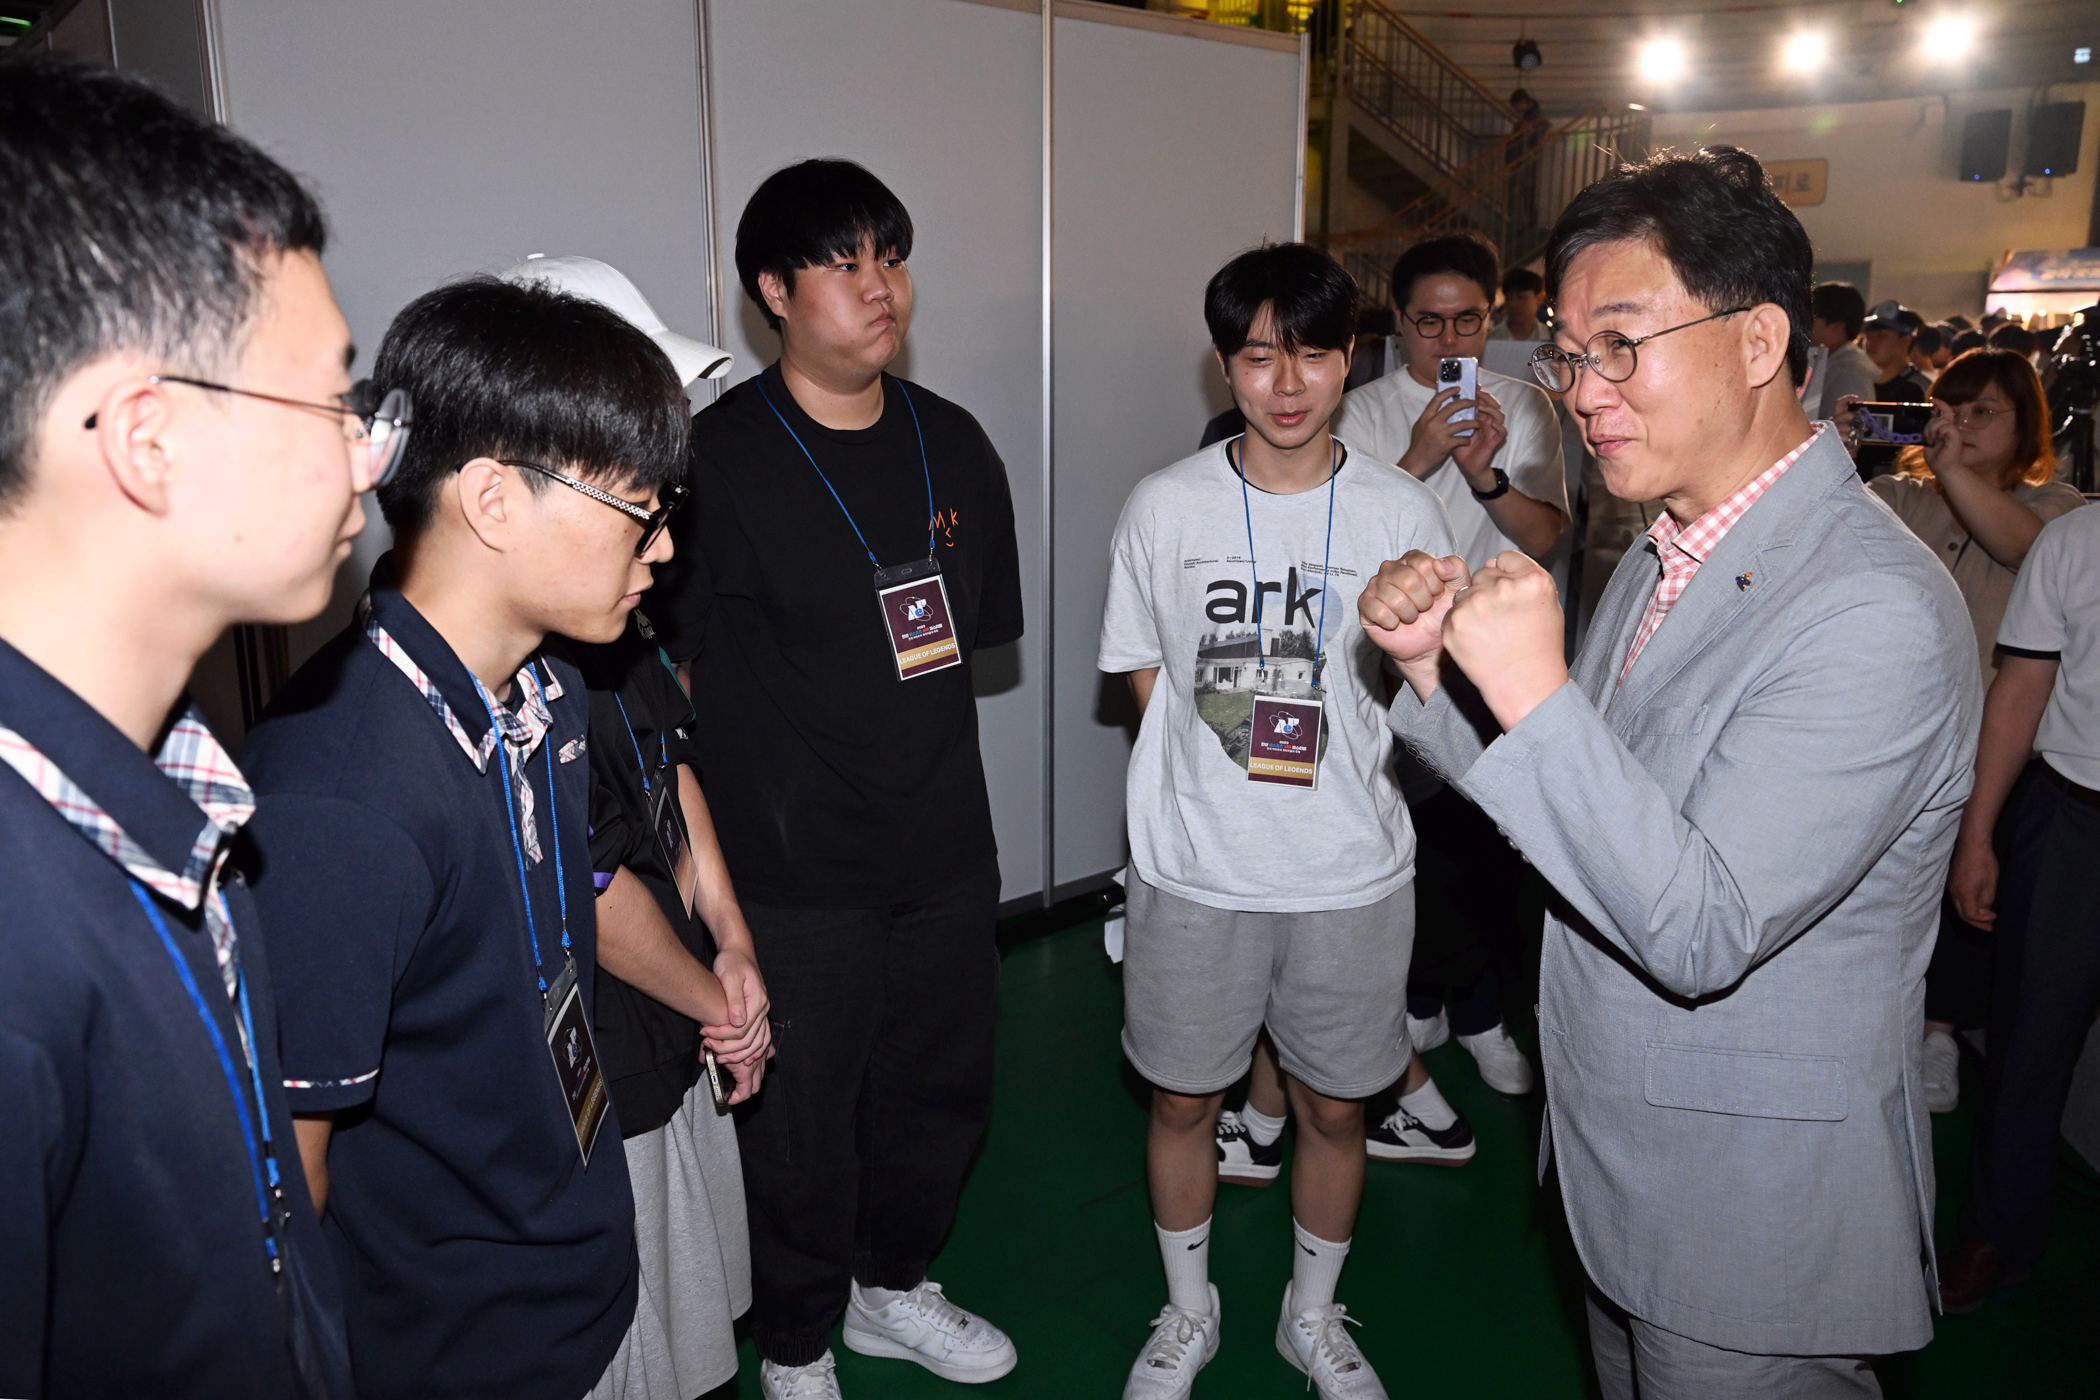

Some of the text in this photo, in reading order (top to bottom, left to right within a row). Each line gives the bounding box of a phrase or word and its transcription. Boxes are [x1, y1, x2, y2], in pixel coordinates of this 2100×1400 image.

[1205, 566, 1324, 629] ark
[899, 653, 922, 664] LEAGUE
[930, 643, 956, 655] LEGENDS
[1249, 762, 1274, 771] LEAGUE
[1284, 766, 1313, 775] LEGENDS
